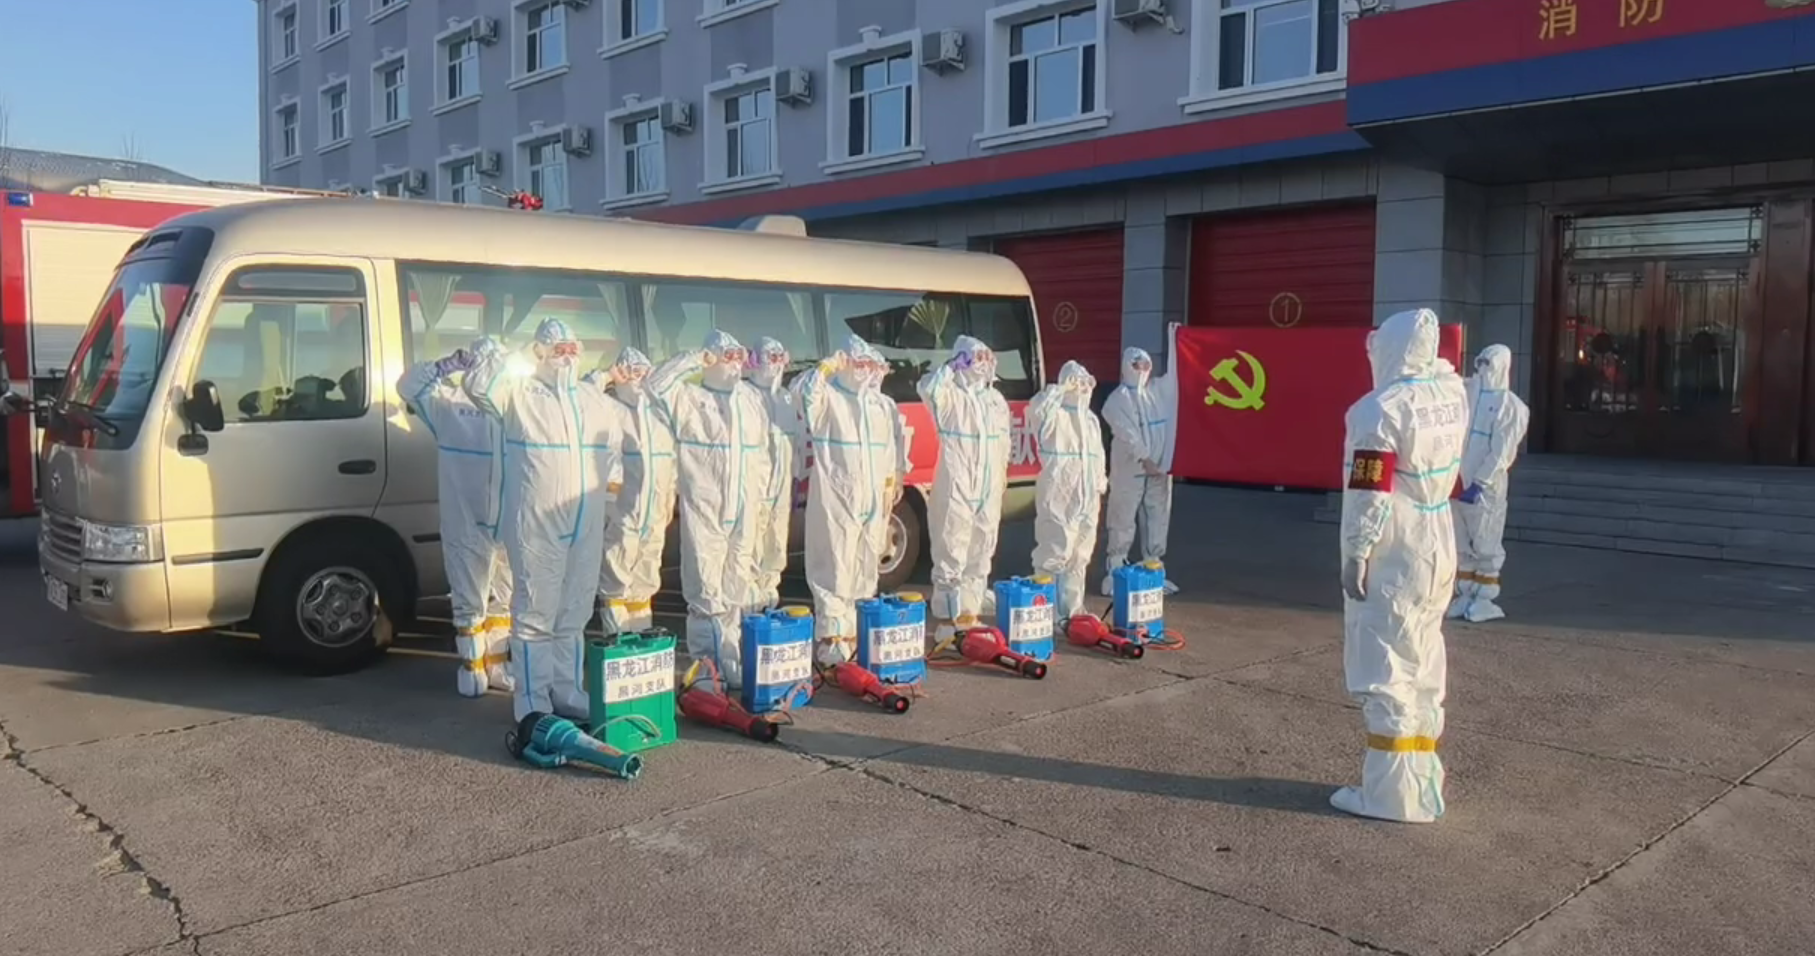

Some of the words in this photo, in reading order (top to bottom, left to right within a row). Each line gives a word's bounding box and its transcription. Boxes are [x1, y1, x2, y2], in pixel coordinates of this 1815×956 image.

[1538, 0, 1664, 40] 消防
[1352, 458, 1384, 483] 保障
[617, 678, 667, 699] 黑河支队
